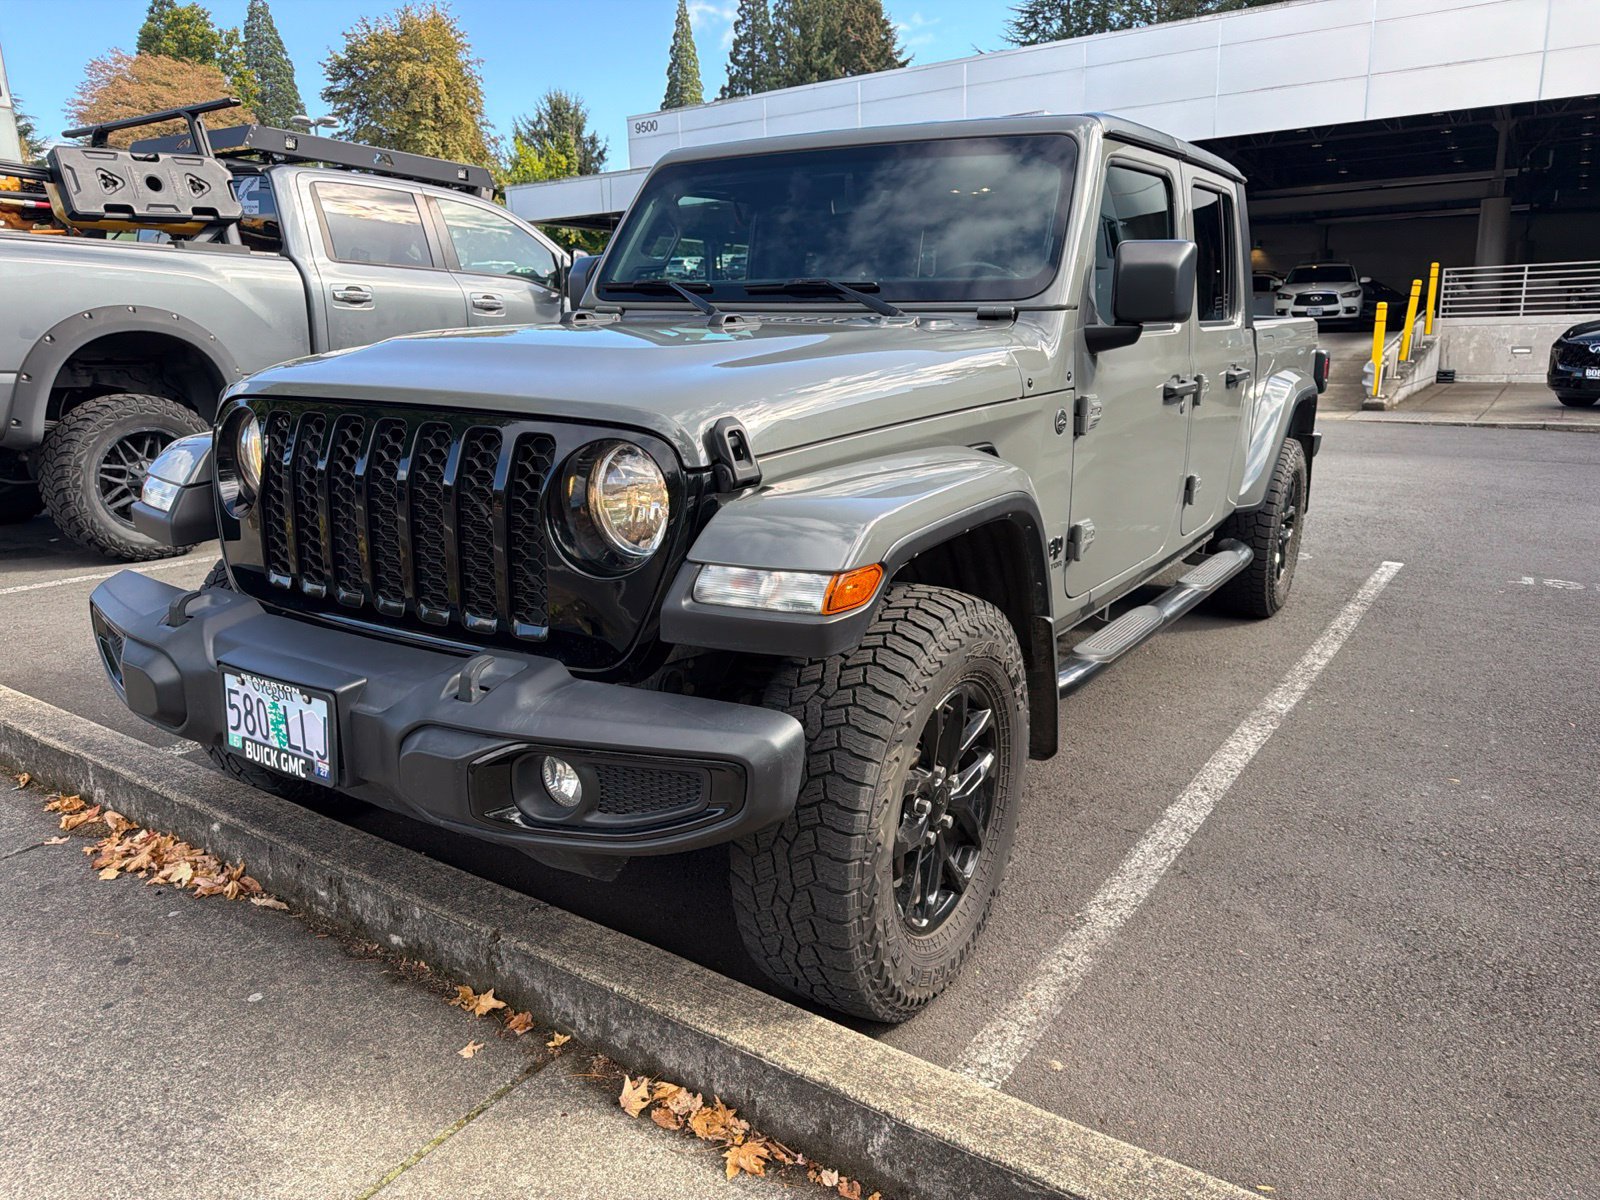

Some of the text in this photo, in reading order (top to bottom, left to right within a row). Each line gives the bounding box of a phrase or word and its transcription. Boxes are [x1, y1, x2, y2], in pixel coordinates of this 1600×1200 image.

[635, 119, 658, 134] 9500
[1050, 560, 1063, 571] TOR
[240, 673, 300, 694] BEAVERTON
[252, 680, 295, 702] Oregon
[227, 688, 328, 760] 580 LLJ
[245, 740, 306, 778] BUICK GMC
[320, 768, 328, 777] 27
